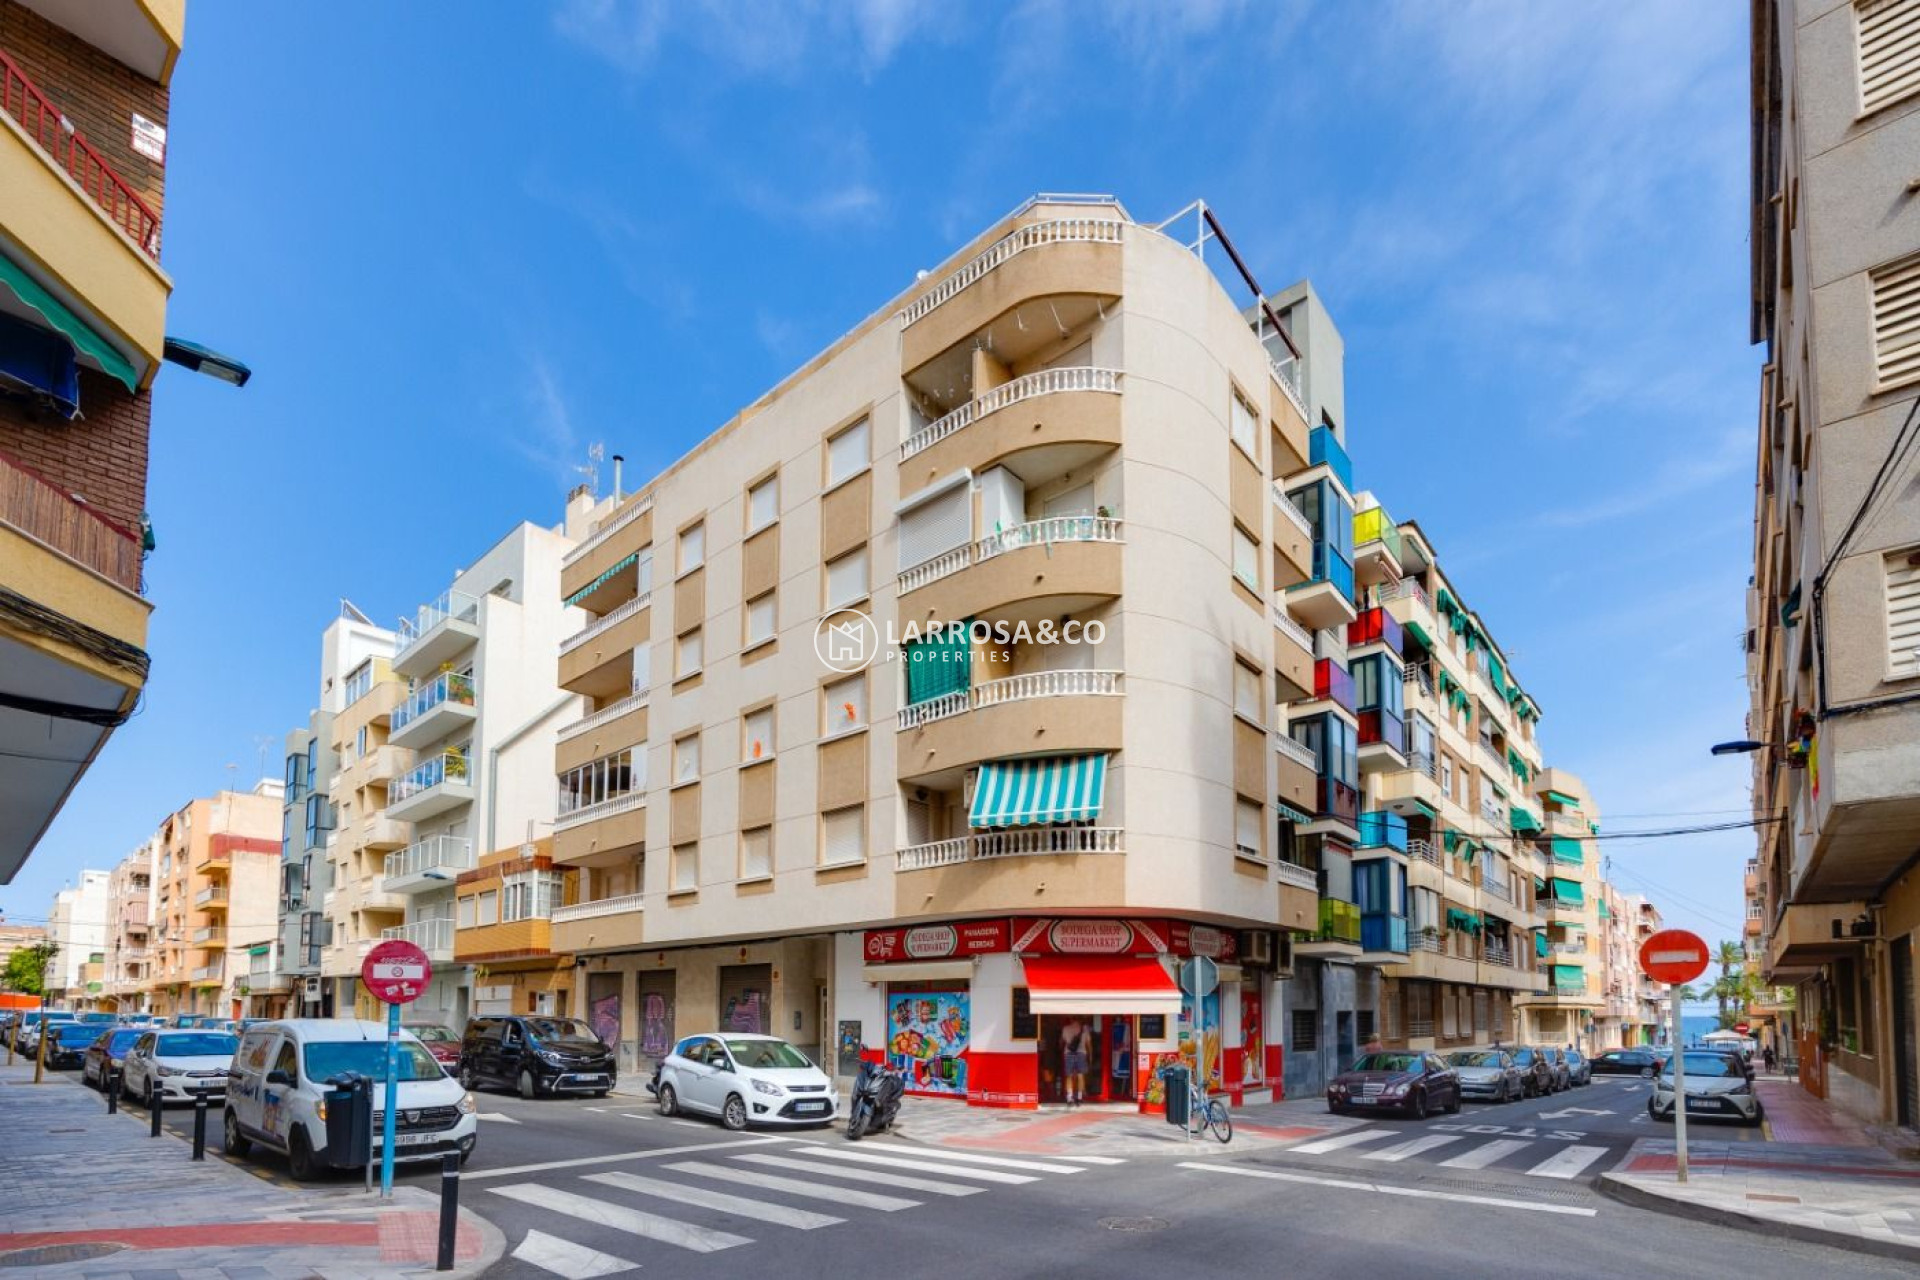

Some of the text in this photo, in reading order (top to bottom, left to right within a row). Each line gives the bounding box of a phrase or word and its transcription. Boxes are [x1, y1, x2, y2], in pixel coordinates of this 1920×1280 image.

[1061, 925, 1121, 935] BODEGA SHOP
[1061, 936, 1121, 948] SUPERMARKET
[1427, 1124, 1588, 1141] STOP
